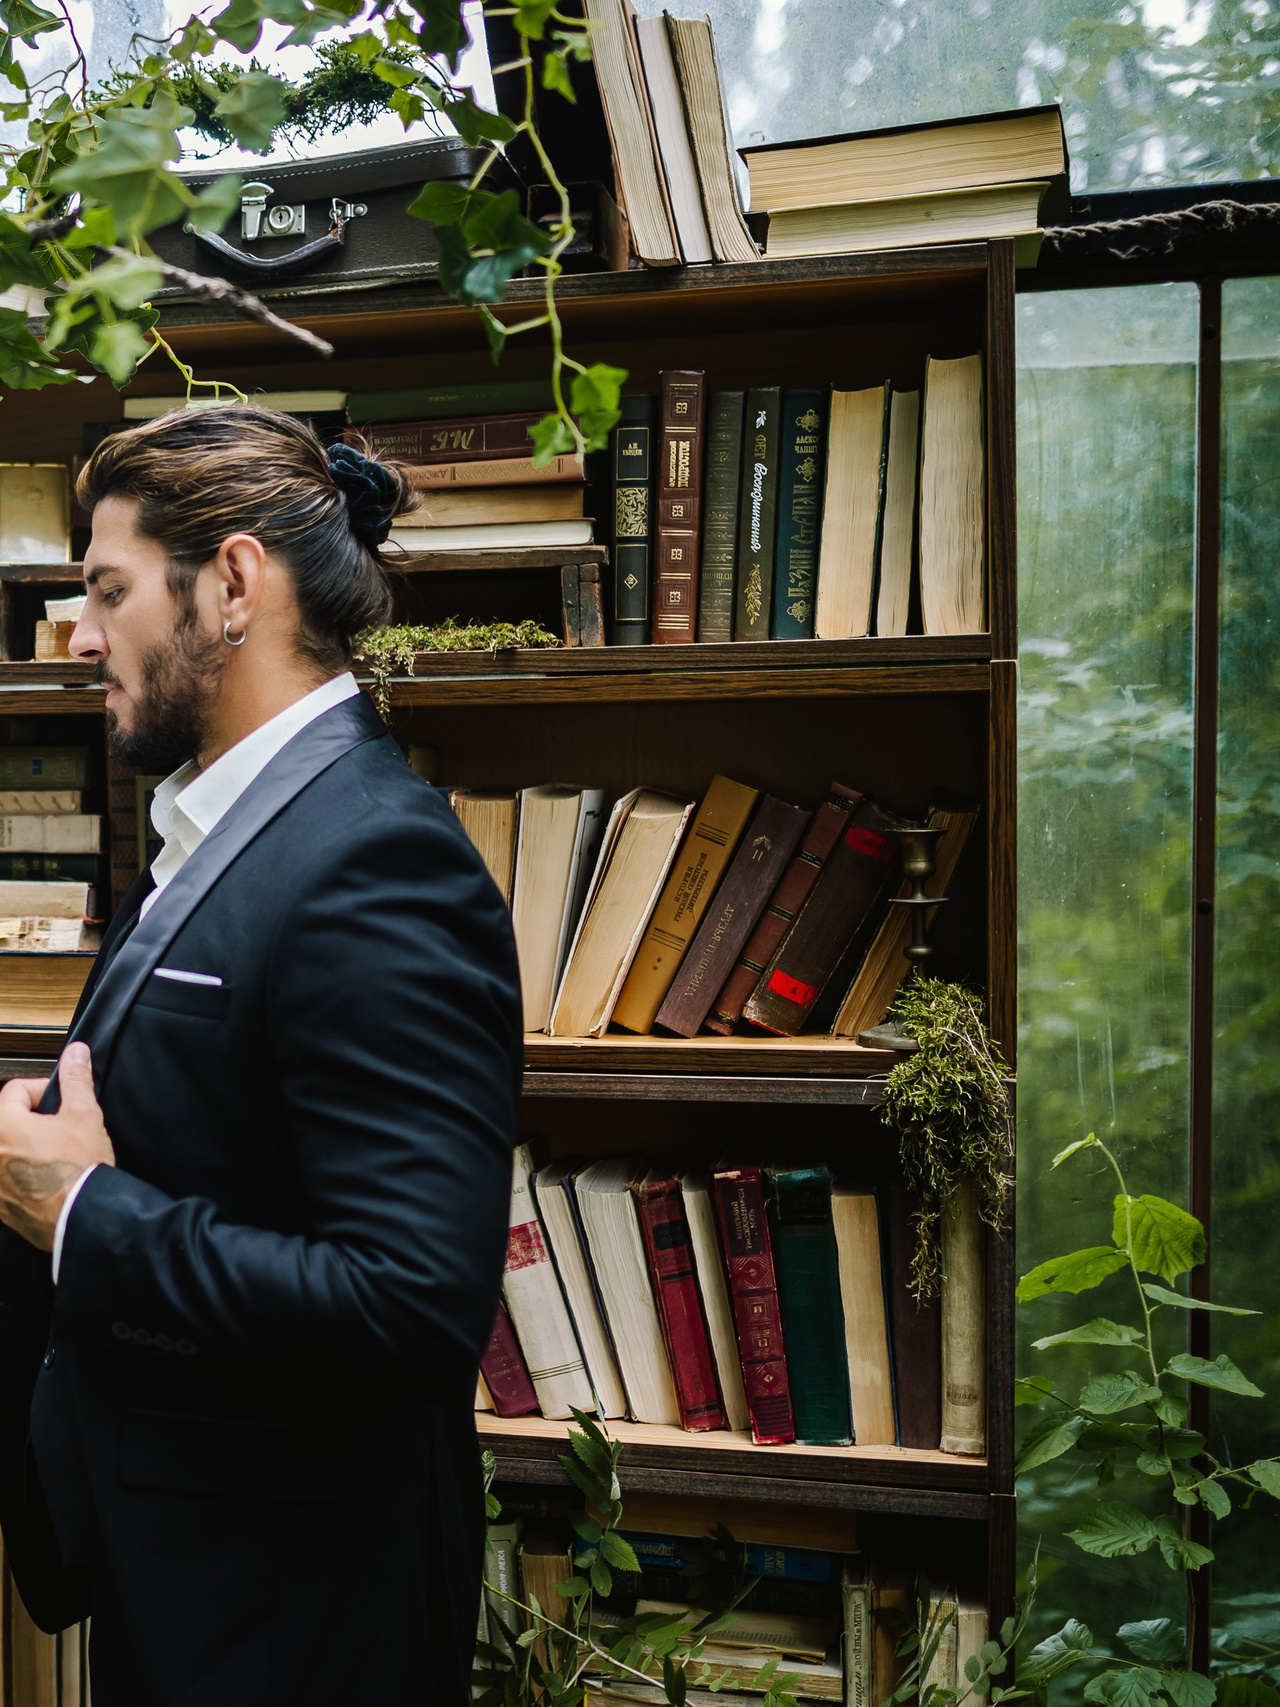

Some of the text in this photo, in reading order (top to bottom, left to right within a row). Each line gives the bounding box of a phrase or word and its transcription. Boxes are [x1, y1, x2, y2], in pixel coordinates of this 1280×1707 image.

[677, 441, 690, 487] ПОДРОСТОК
[750, 434, 768, 554] ФЕТ Воспоминания
[673, 866, 694, 903] ИСТОРИЯ
[673, 892, 691, 923] РУССКОЙ
[684, 904, 735, 996] ДРУЗЬЯ ПУШКИНА
[498, 1550, 509, 1603] УРЮМ-РЕКА
